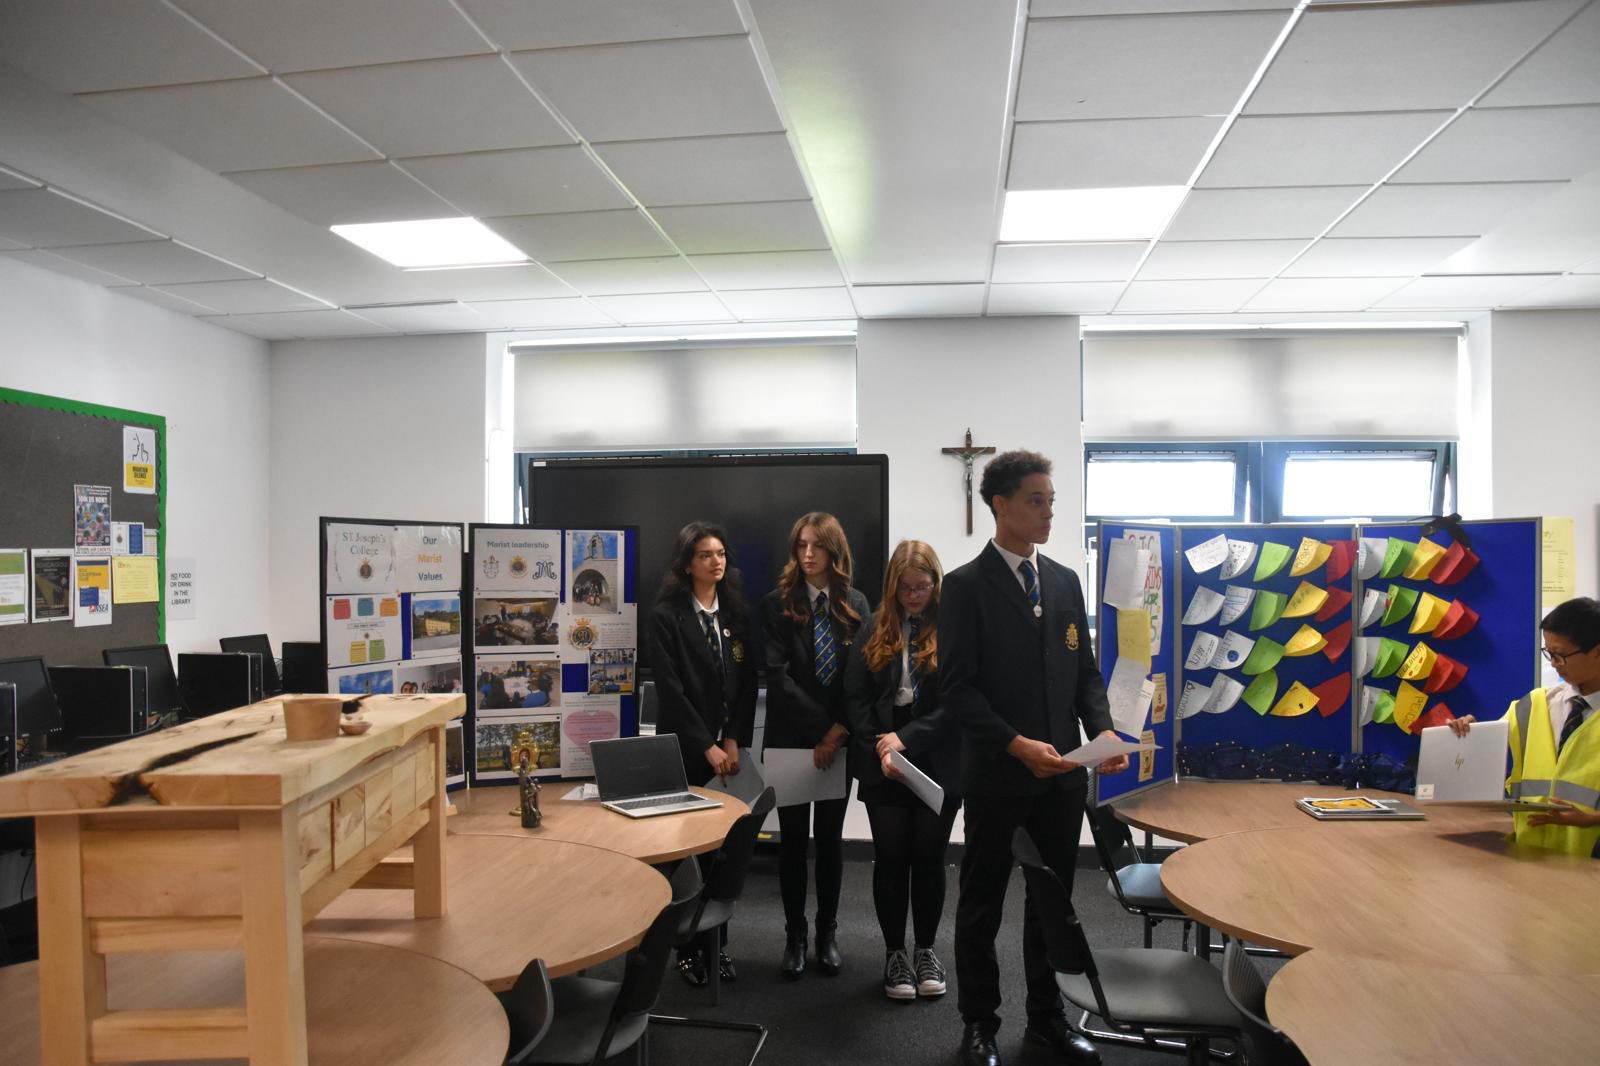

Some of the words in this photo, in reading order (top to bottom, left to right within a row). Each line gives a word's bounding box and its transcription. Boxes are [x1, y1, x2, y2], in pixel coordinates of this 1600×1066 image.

[422, 536, 437, 545] Our
[511, 540, 550, 550] leadership
[350, 545, 379, 556] College
[417, 572, 442, 581] Values
